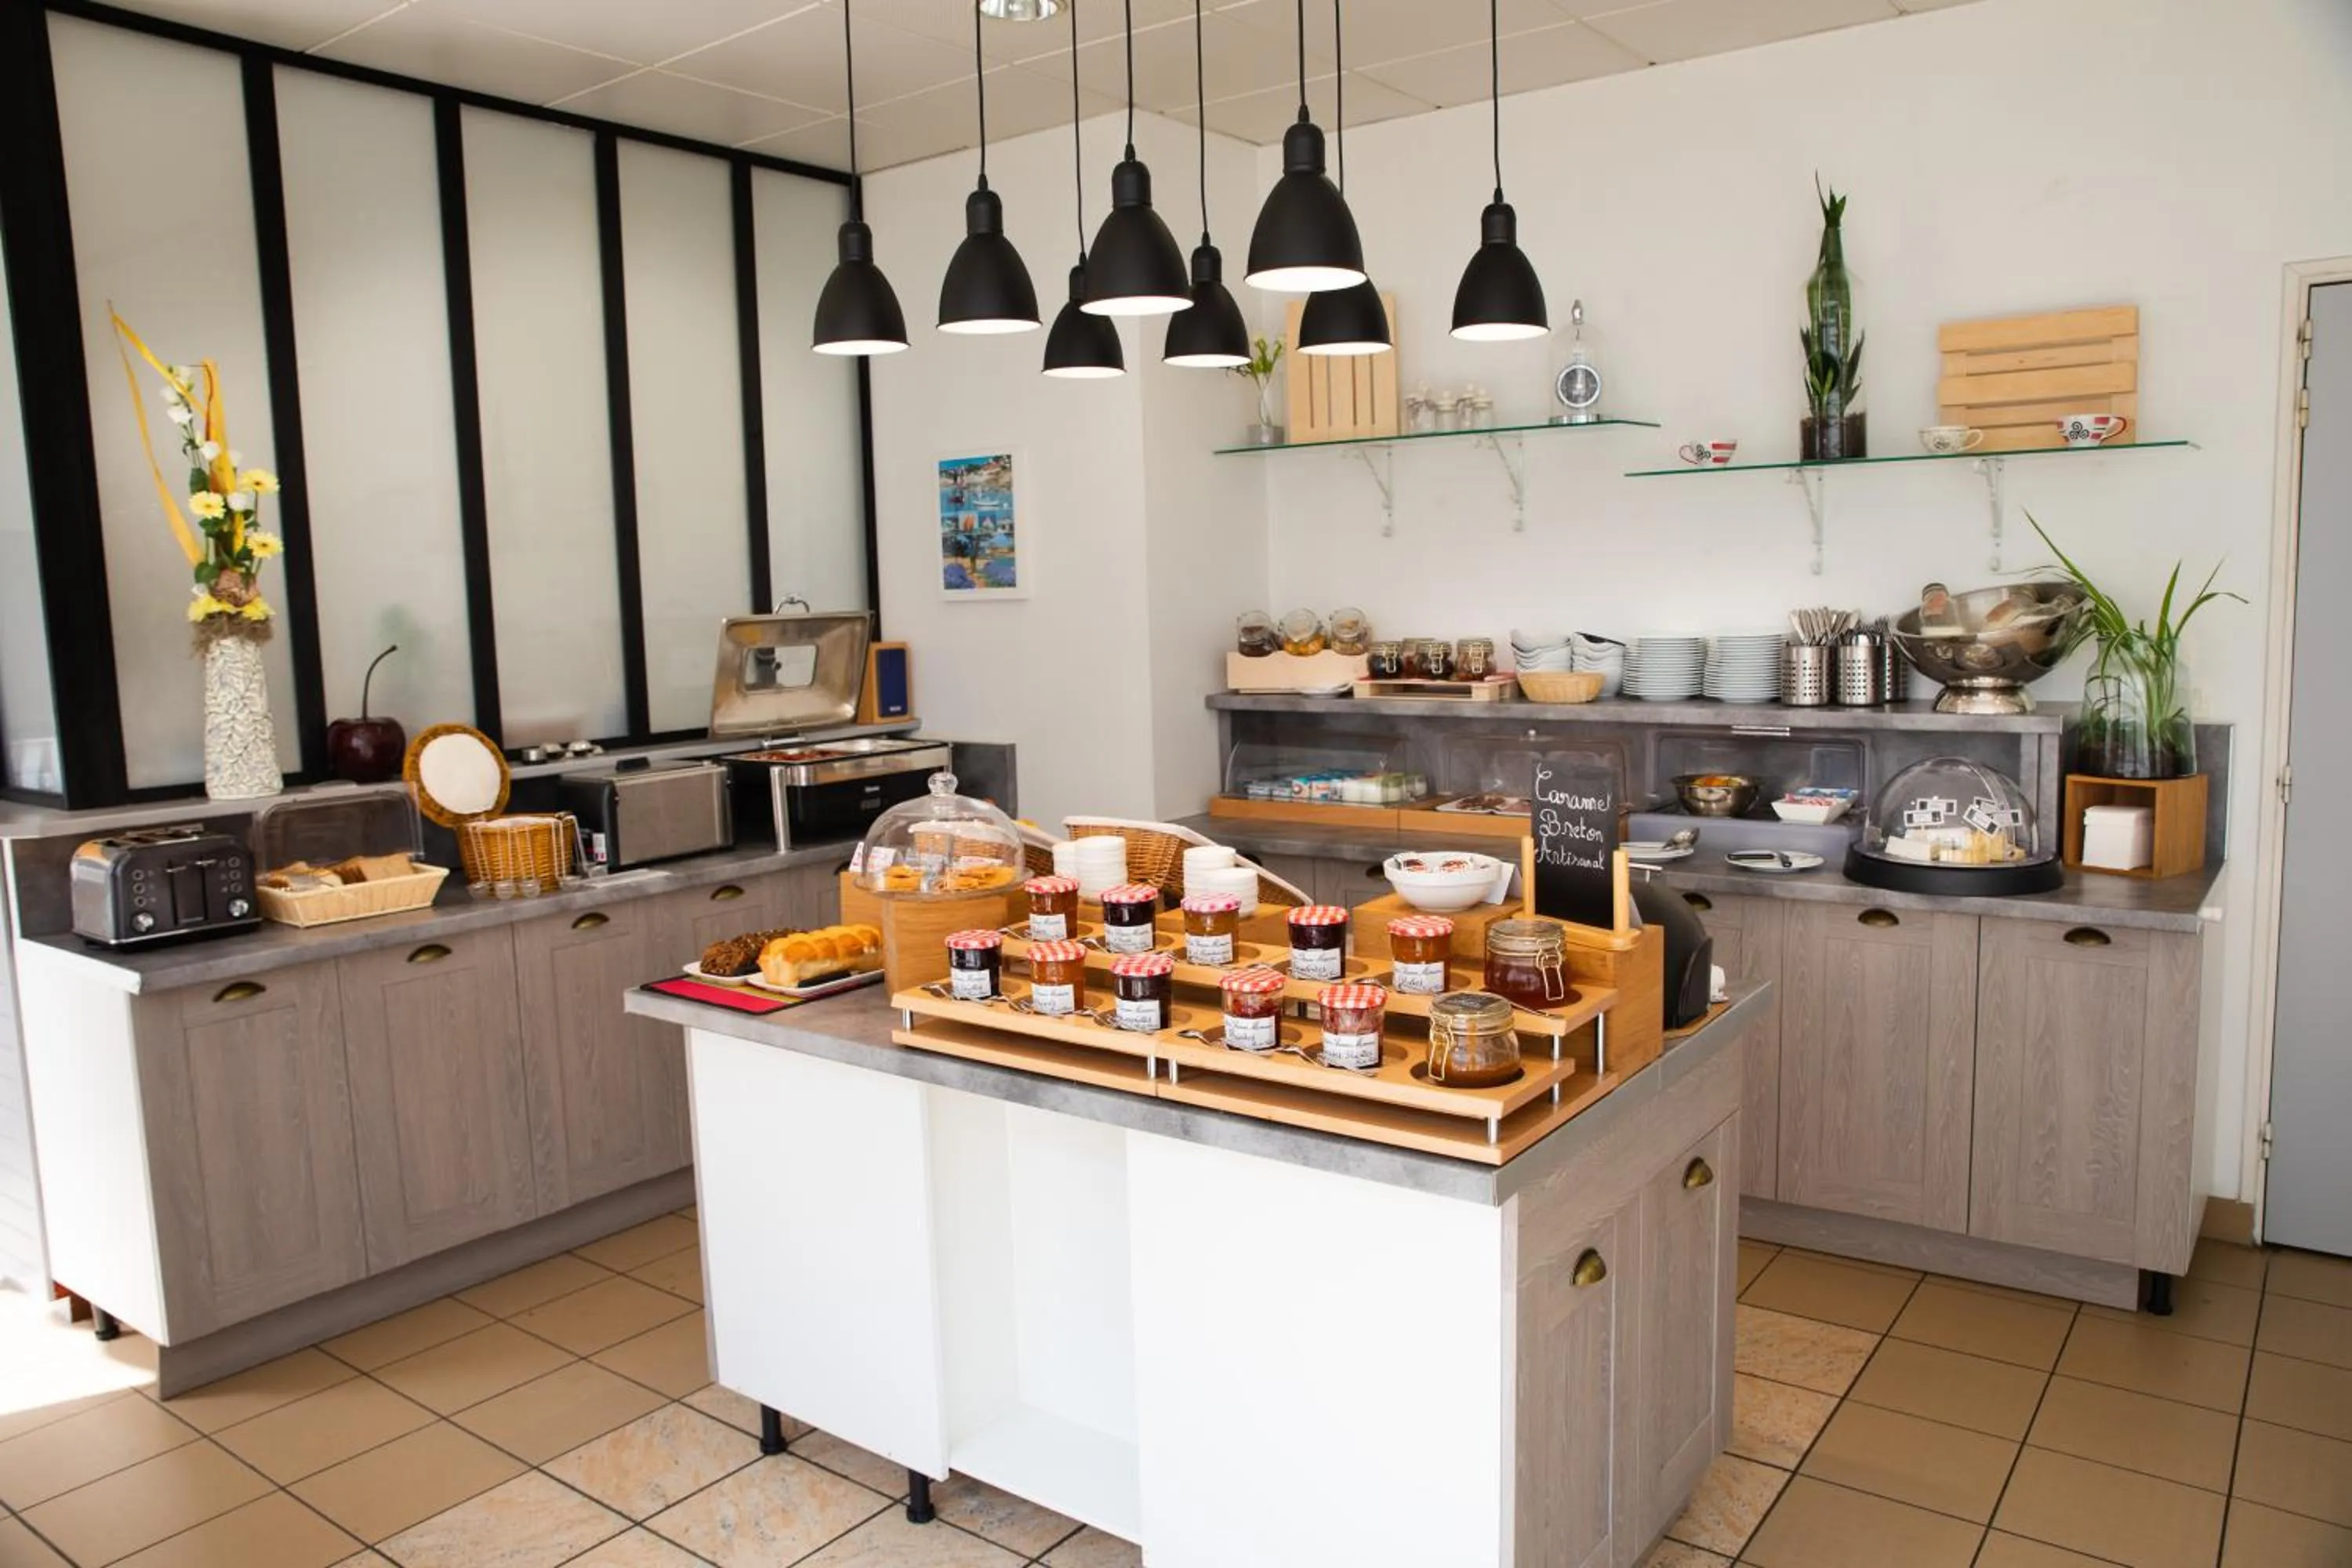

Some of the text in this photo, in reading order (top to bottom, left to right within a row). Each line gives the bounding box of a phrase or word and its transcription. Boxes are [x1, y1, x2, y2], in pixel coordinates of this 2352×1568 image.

[1535, 763, 1612, 812] Caramel
[1539, 808, 1604, 844] Breton
[1534, 837, 1605, 870] Artisanal
